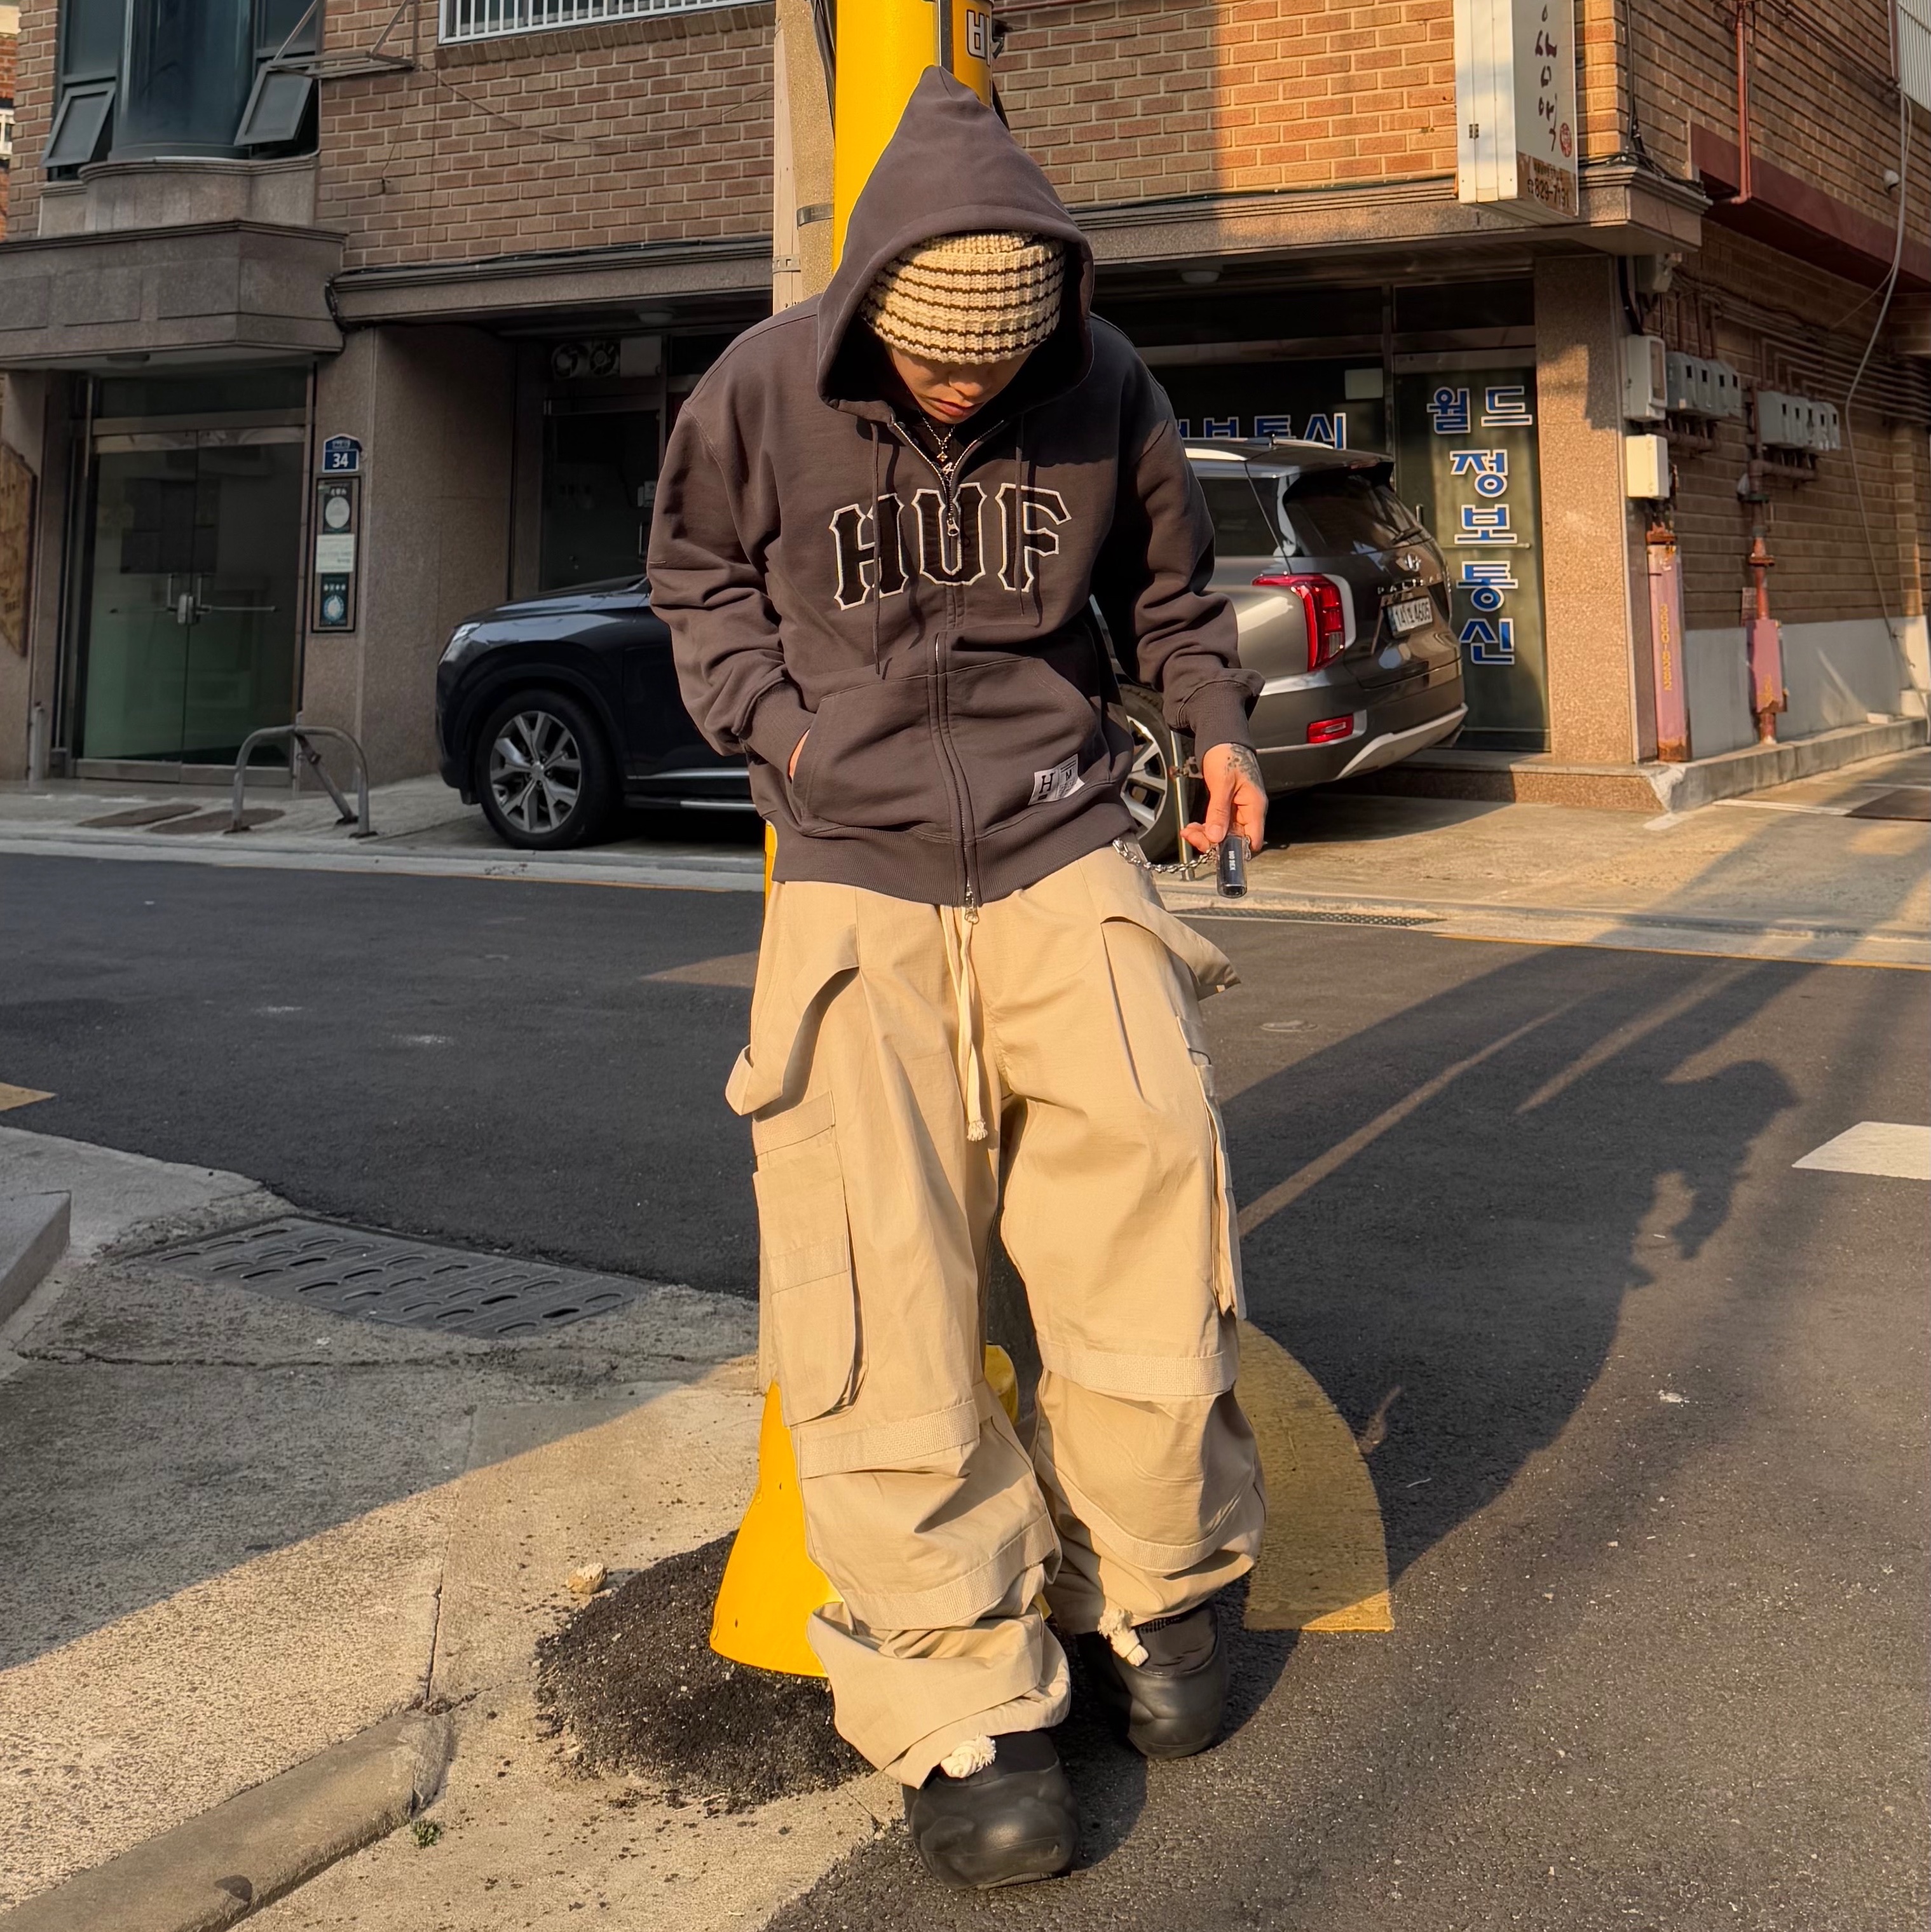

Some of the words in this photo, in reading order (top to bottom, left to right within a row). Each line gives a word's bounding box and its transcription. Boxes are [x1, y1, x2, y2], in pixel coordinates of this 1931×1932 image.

[1426, 385, 1532, 434] 월드
[332, 452, 349, 468] 34
[828, 482, 1072, 611] HUF
[1450, 449, 1518, 665] 정보통신
